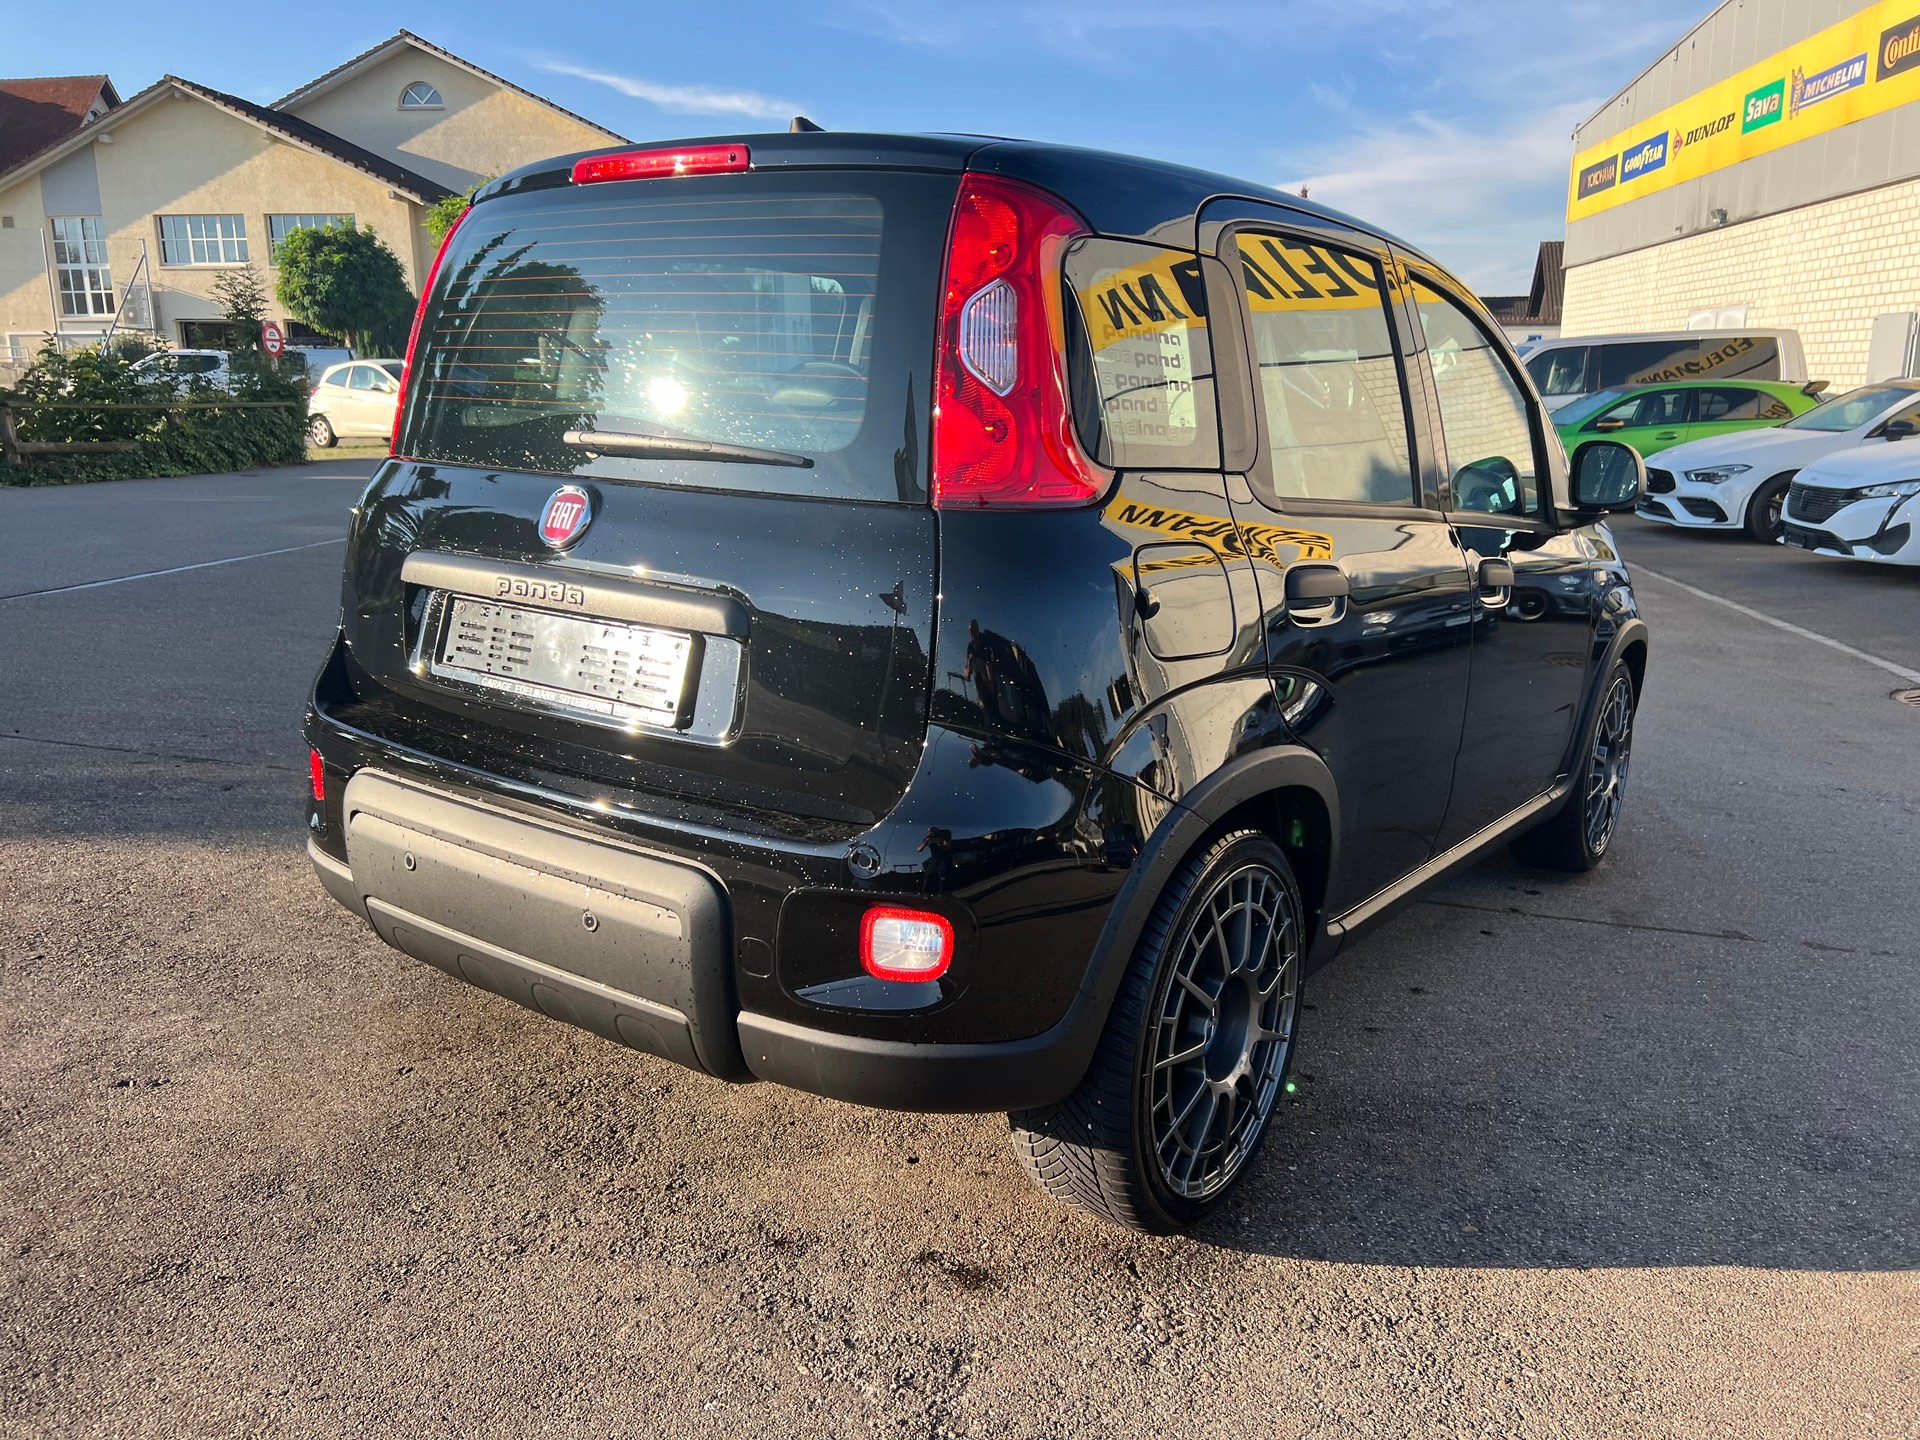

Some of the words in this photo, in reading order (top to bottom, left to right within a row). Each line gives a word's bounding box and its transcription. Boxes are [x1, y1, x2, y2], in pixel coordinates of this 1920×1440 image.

[1804, 60, 1864, 99] MICHELIN
[1746, 93, 1780, 123] Sava
[1685, 112, 1735, 146] DUNLOP
[1624, 143, 1664, 173] GOODYEAR
[1587, 164, 1615, 188] YOKOHAMA
[547, 501, 581, 530] FIAT
[496, 577, 584, 605] panda
[481, 677, 512, 692] GARAGE
[514, 684, 556, 700] EDELMANN
